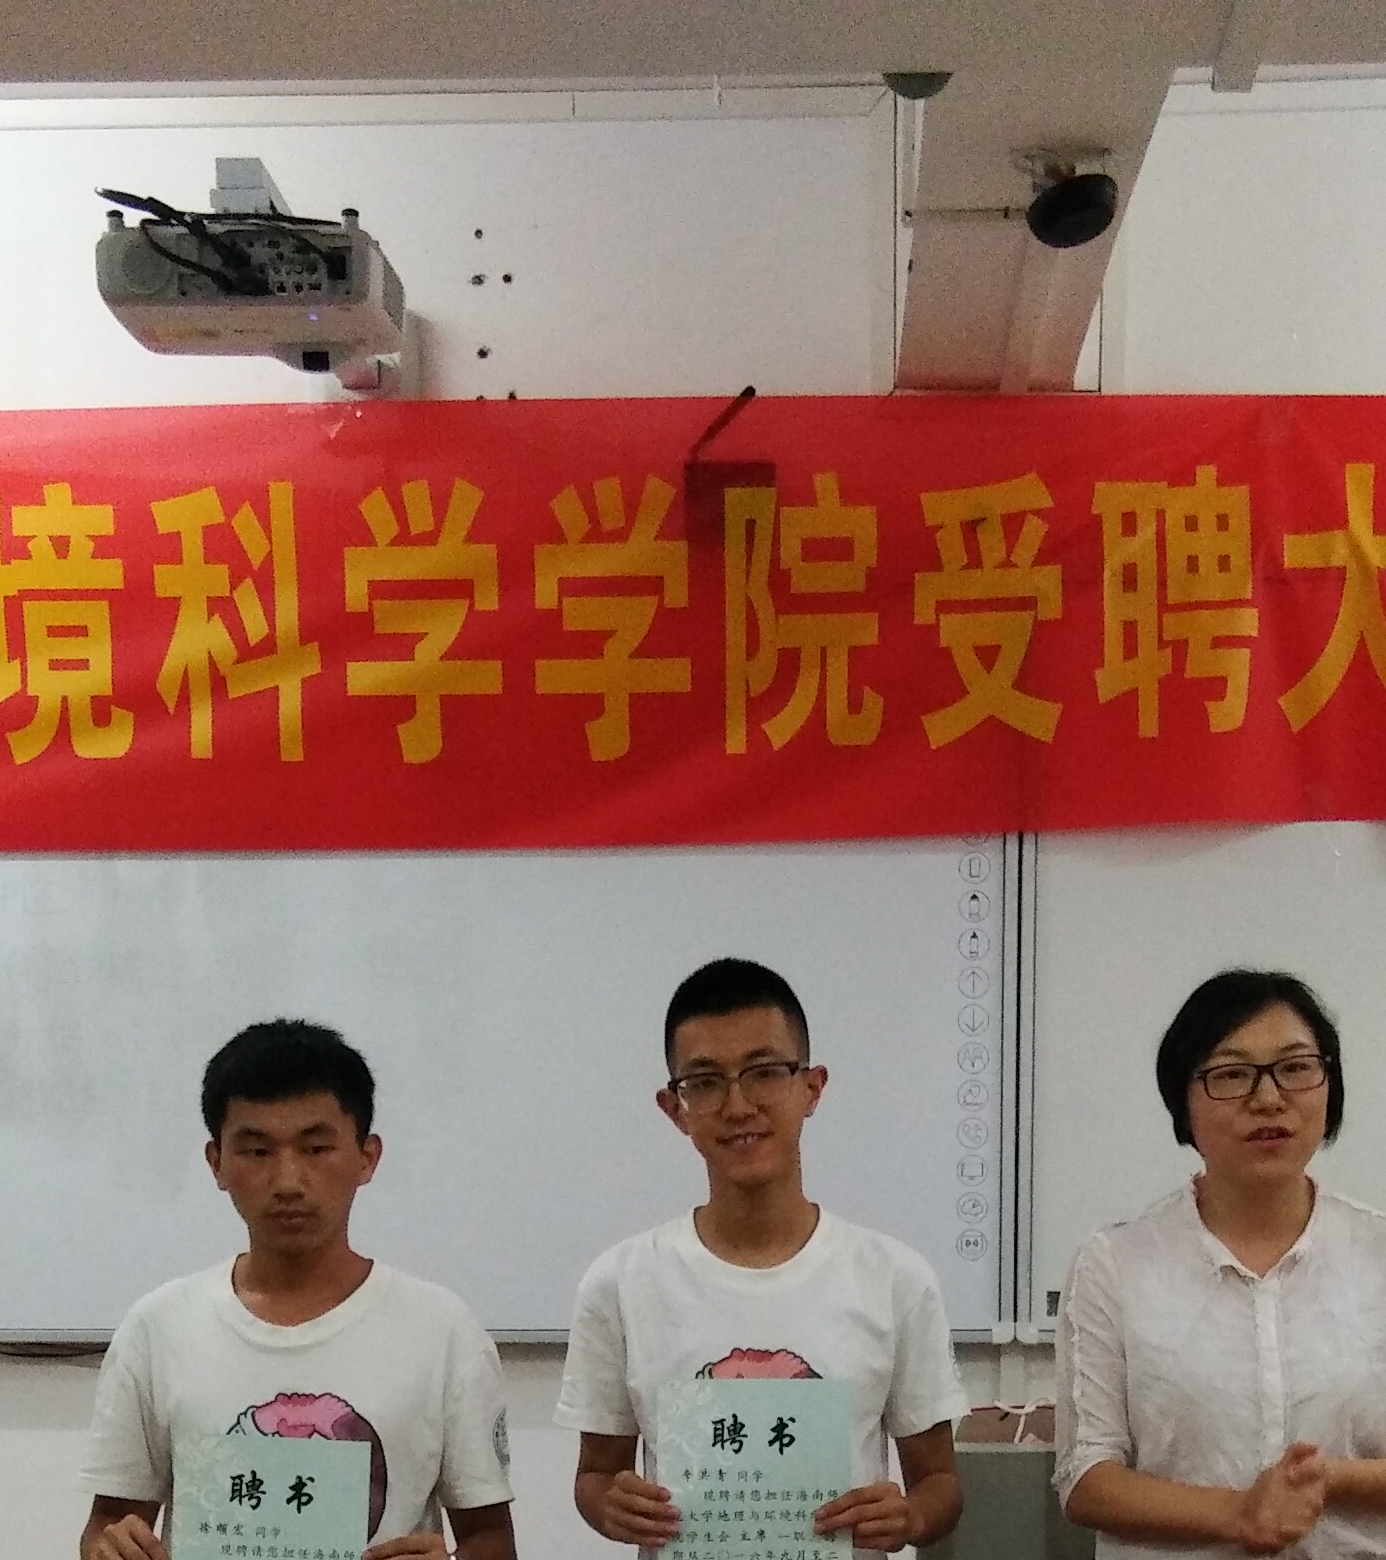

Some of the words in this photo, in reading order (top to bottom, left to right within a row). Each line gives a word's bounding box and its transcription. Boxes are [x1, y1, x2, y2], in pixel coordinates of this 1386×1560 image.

[711, 1413, 797, 1456] 聘书
[229, 1470, 316, 1515] 聘书
[675, 1508, 819, 1524] 大学地理与环境科
